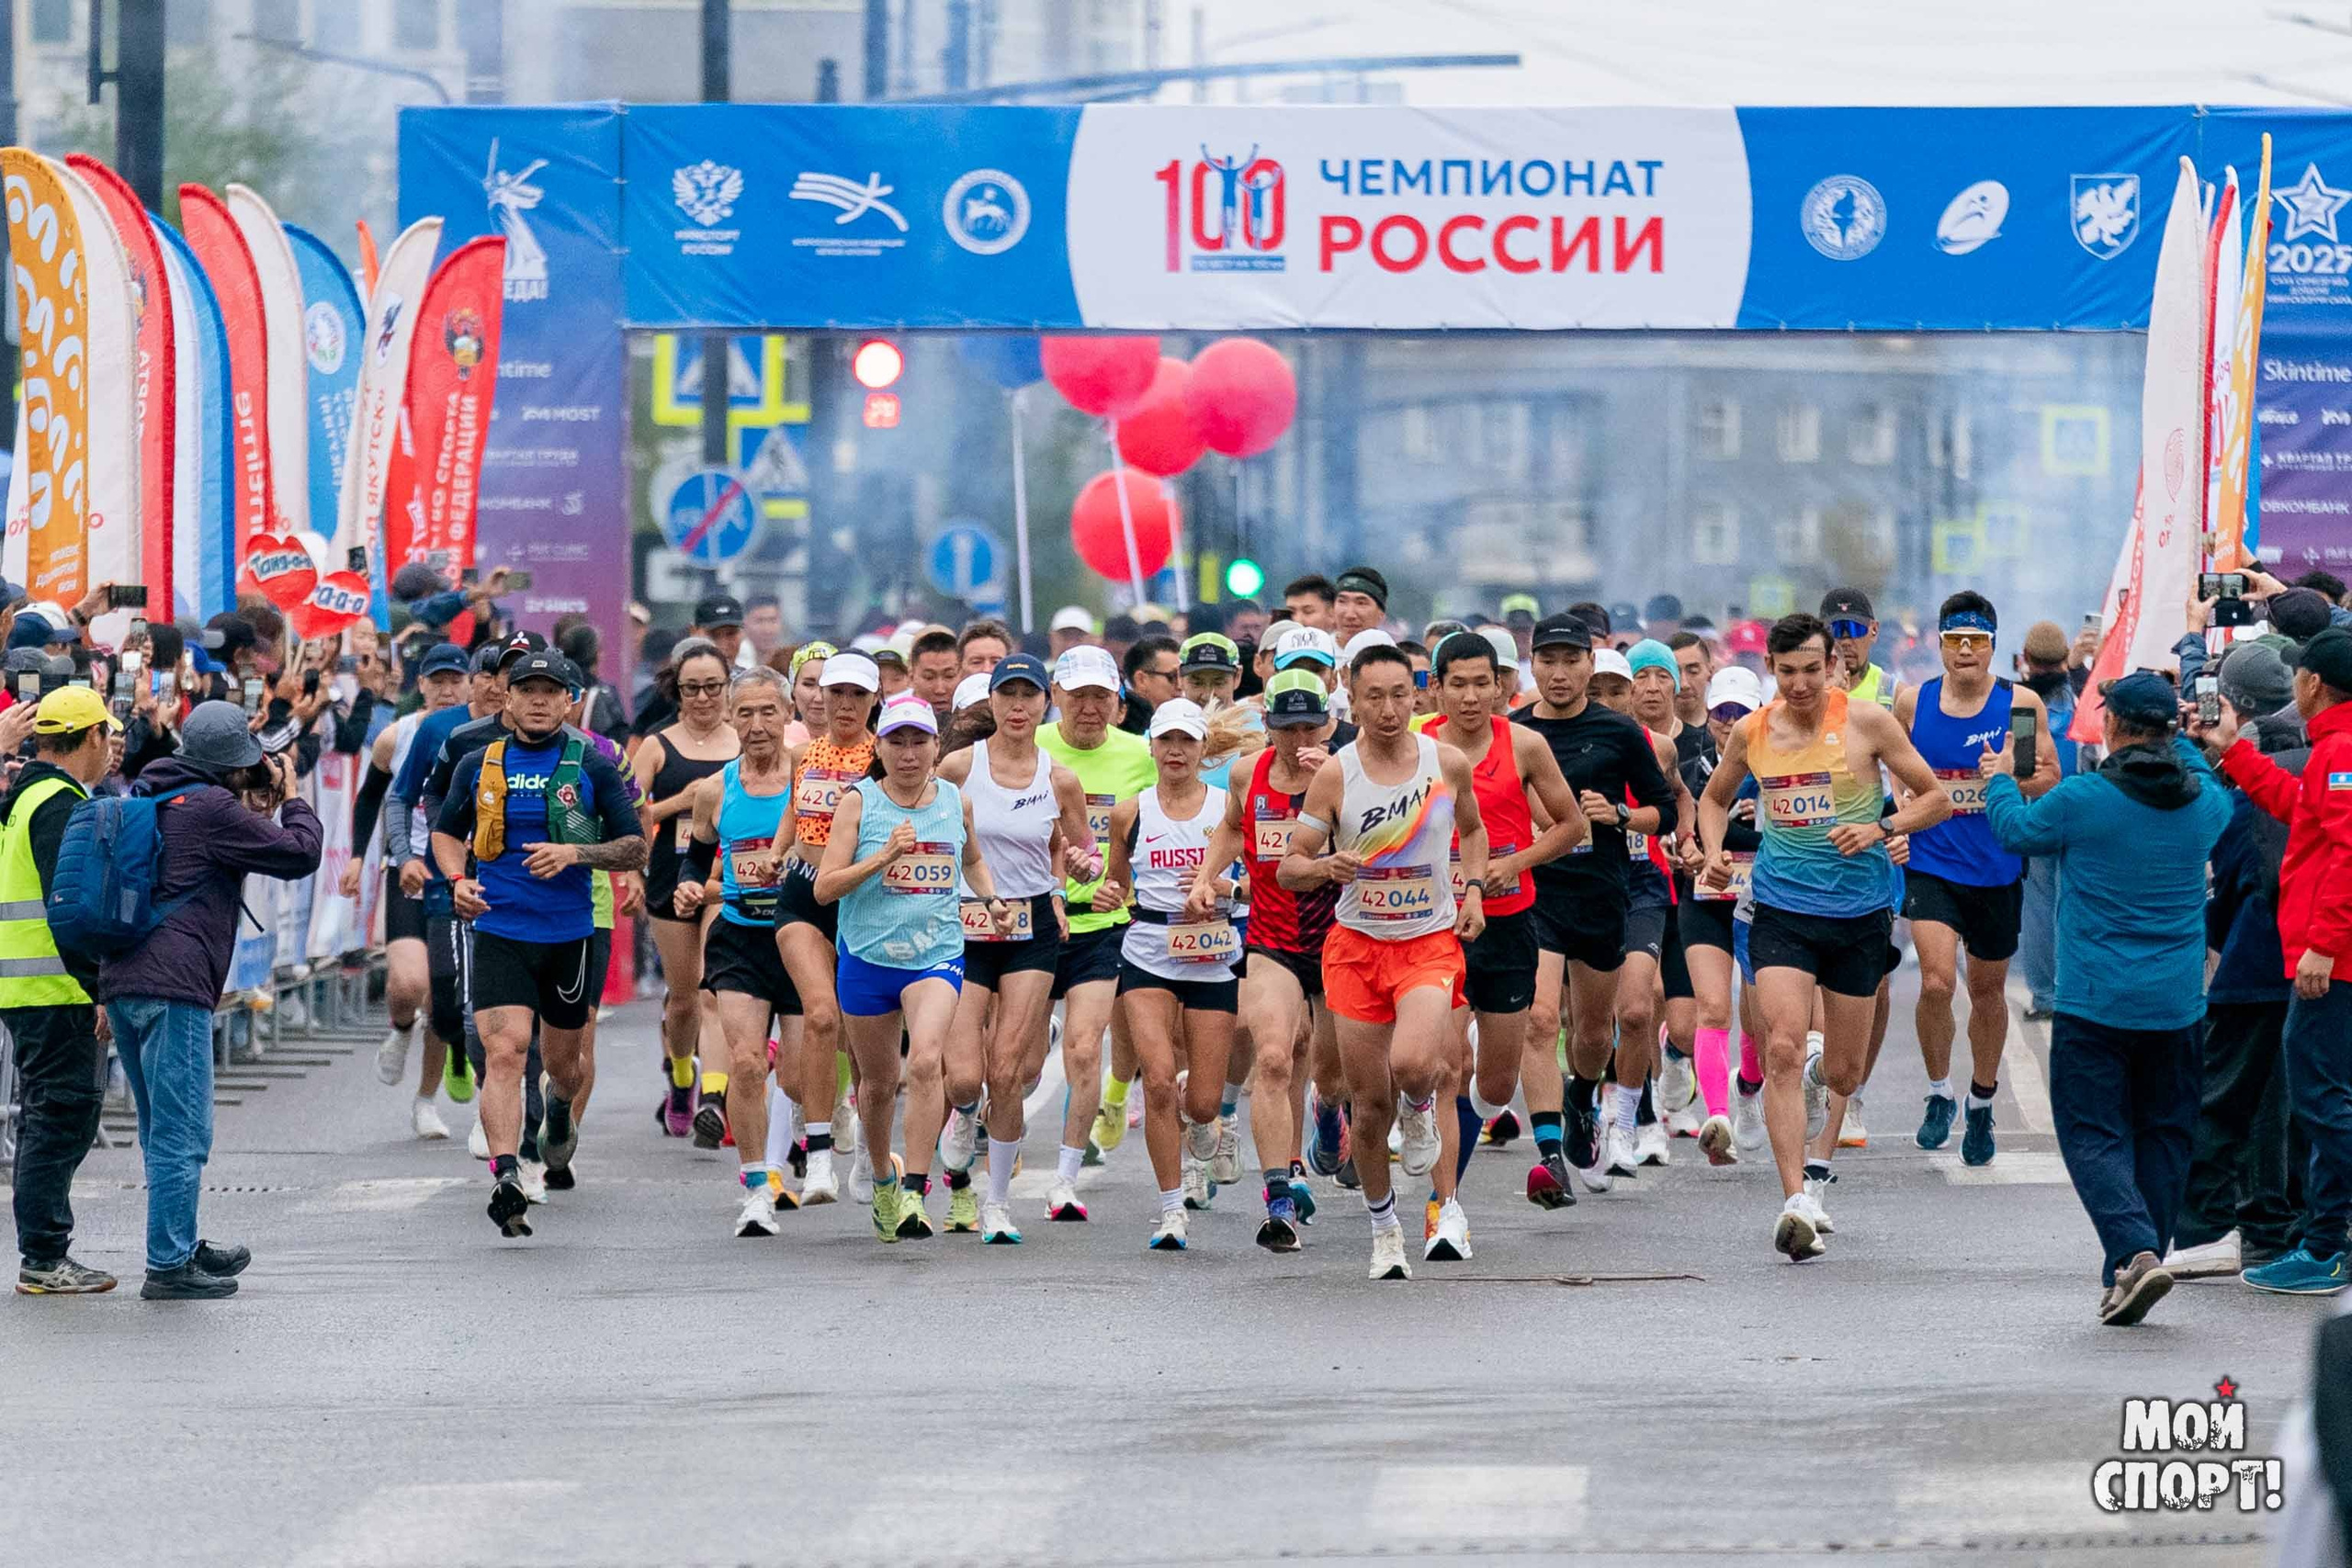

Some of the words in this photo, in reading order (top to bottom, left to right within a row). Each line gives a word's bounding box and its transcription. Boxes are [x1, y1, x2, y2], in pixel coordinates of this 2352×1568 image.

[1318, 159, 1664, 197] ЧЕМПИОНАТ
[1318, 213, 1665, 274] РОССИИ
[2268, 243, 2352, 274] 2025
[2263, 358, 2352, 383] Skintime
[448, 394, 479, 541] ФЕДЕРАЦИИ
[2260, 499, 2350, 515] ОВКОМБАНК
[1772, 795, 1831, 815] 42014
[1150, 847, 1206, 869] RUSSI
[887, 864, 952, 882] 42059
[1362, 887, 1430, 908] 42044
[1171, 930, 1233, 951] 42042
